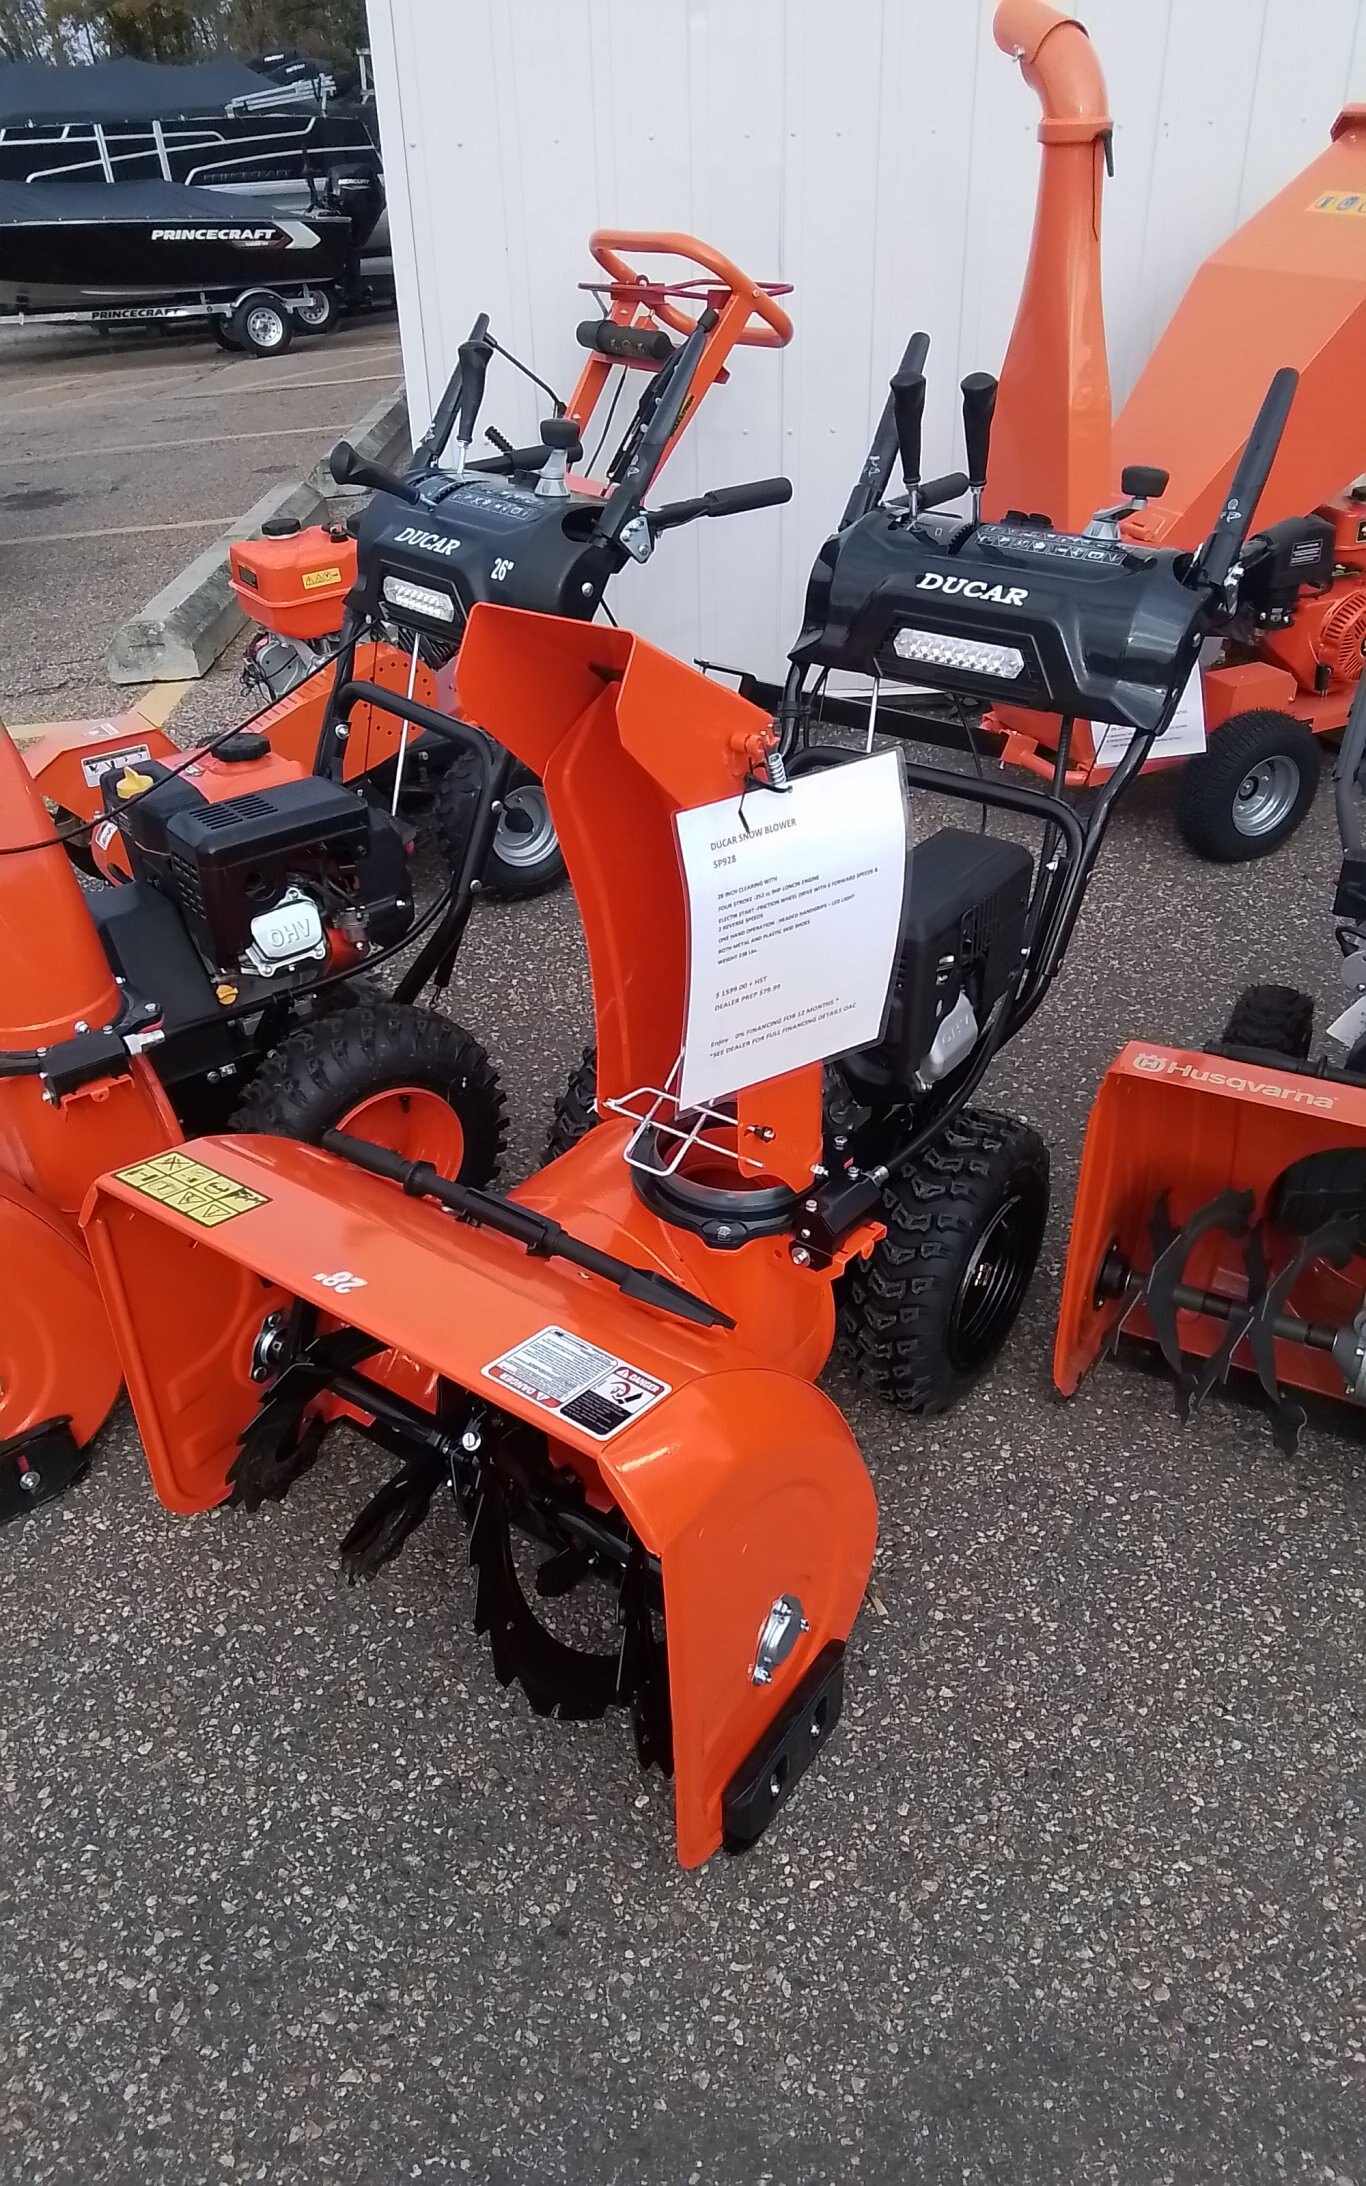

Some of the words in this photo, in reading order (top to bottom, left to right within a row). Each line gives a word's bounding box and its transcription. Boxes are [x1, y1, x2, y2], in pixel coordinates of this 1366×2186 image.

[152, 230, 276, 240] PRINCECRAFT
[92, 308, 182, 319] PRINCECRAFT
[394, 528, 460, 555] DUCAR
[491, 558, 514, 581] 26"
[916, 573, 1028, 606] DUCAR
[711, 836, 737, 850] DUCAR
[739, 828, 762, 842] SNOW
[765, 818, 796, 834] BLOWER
[713, 855, 736, 868] SP928
[734, 897, 752, 907] STROKE
[802, 875, 819, 884] ENGINE
[739, 881, 763, 893] CLEARING
[764, 876, 777, 884] WITH
[739, 908, 754, 917] START
[781, 895, 797, 903] WHEEL
[799, 889, 812, 897] DRIVE
[814, 884, 826, 892] WITH
[832, 875, 855, 886] FORWARD
[857, 869, 873, 878] SPEEDS
[723, 920, 743, 930] REVERSE
[746, 913, 763, 923] SPEEDS
[746, 921, 774, 934] OPERATION
[800, 904, 826, 916] HANDGRIPS
[841, 894, 854, 902] LIGHT
[271, 919, 309, 948] OHV
[718, 946, 732, 954] BOTH
[733, 940, 749, 948] METAL
[763, 930, 782, 939] PLASTIC
[795, 920, 810, 928] SHOES
[718, 955, 737, 965] WEIGHT
[755, 976, 767, 985] HST
[715, 998, 739, 1011] DEALER
[741, 992, 758, 1002] PREP
[711, 1038, 728, 1047] Enjoy
[747, 1018, 782, 1034] FINANCING
[783, 1013, 796, 1022] FOR
[806, 1000, 833, 1013] MONTHS
[726, 1041, 750, 1053] DEALER
[752, 1036, 764, 1044] FOR
[766, 1030, 780, 1039] FULL
[782, 1017, 816, 1033] FINANCING
[818, 1008, 841, 1020] DETAILS
[843, 1002, 856, 1011] OAC
[1167, 1062, 1335, 1108] Husqvarna
[312, 1271, 368, 1294] 28"
[500, 1372, 536, 1395] DANGER
[629, 1373, 660, 1394] DANGER
